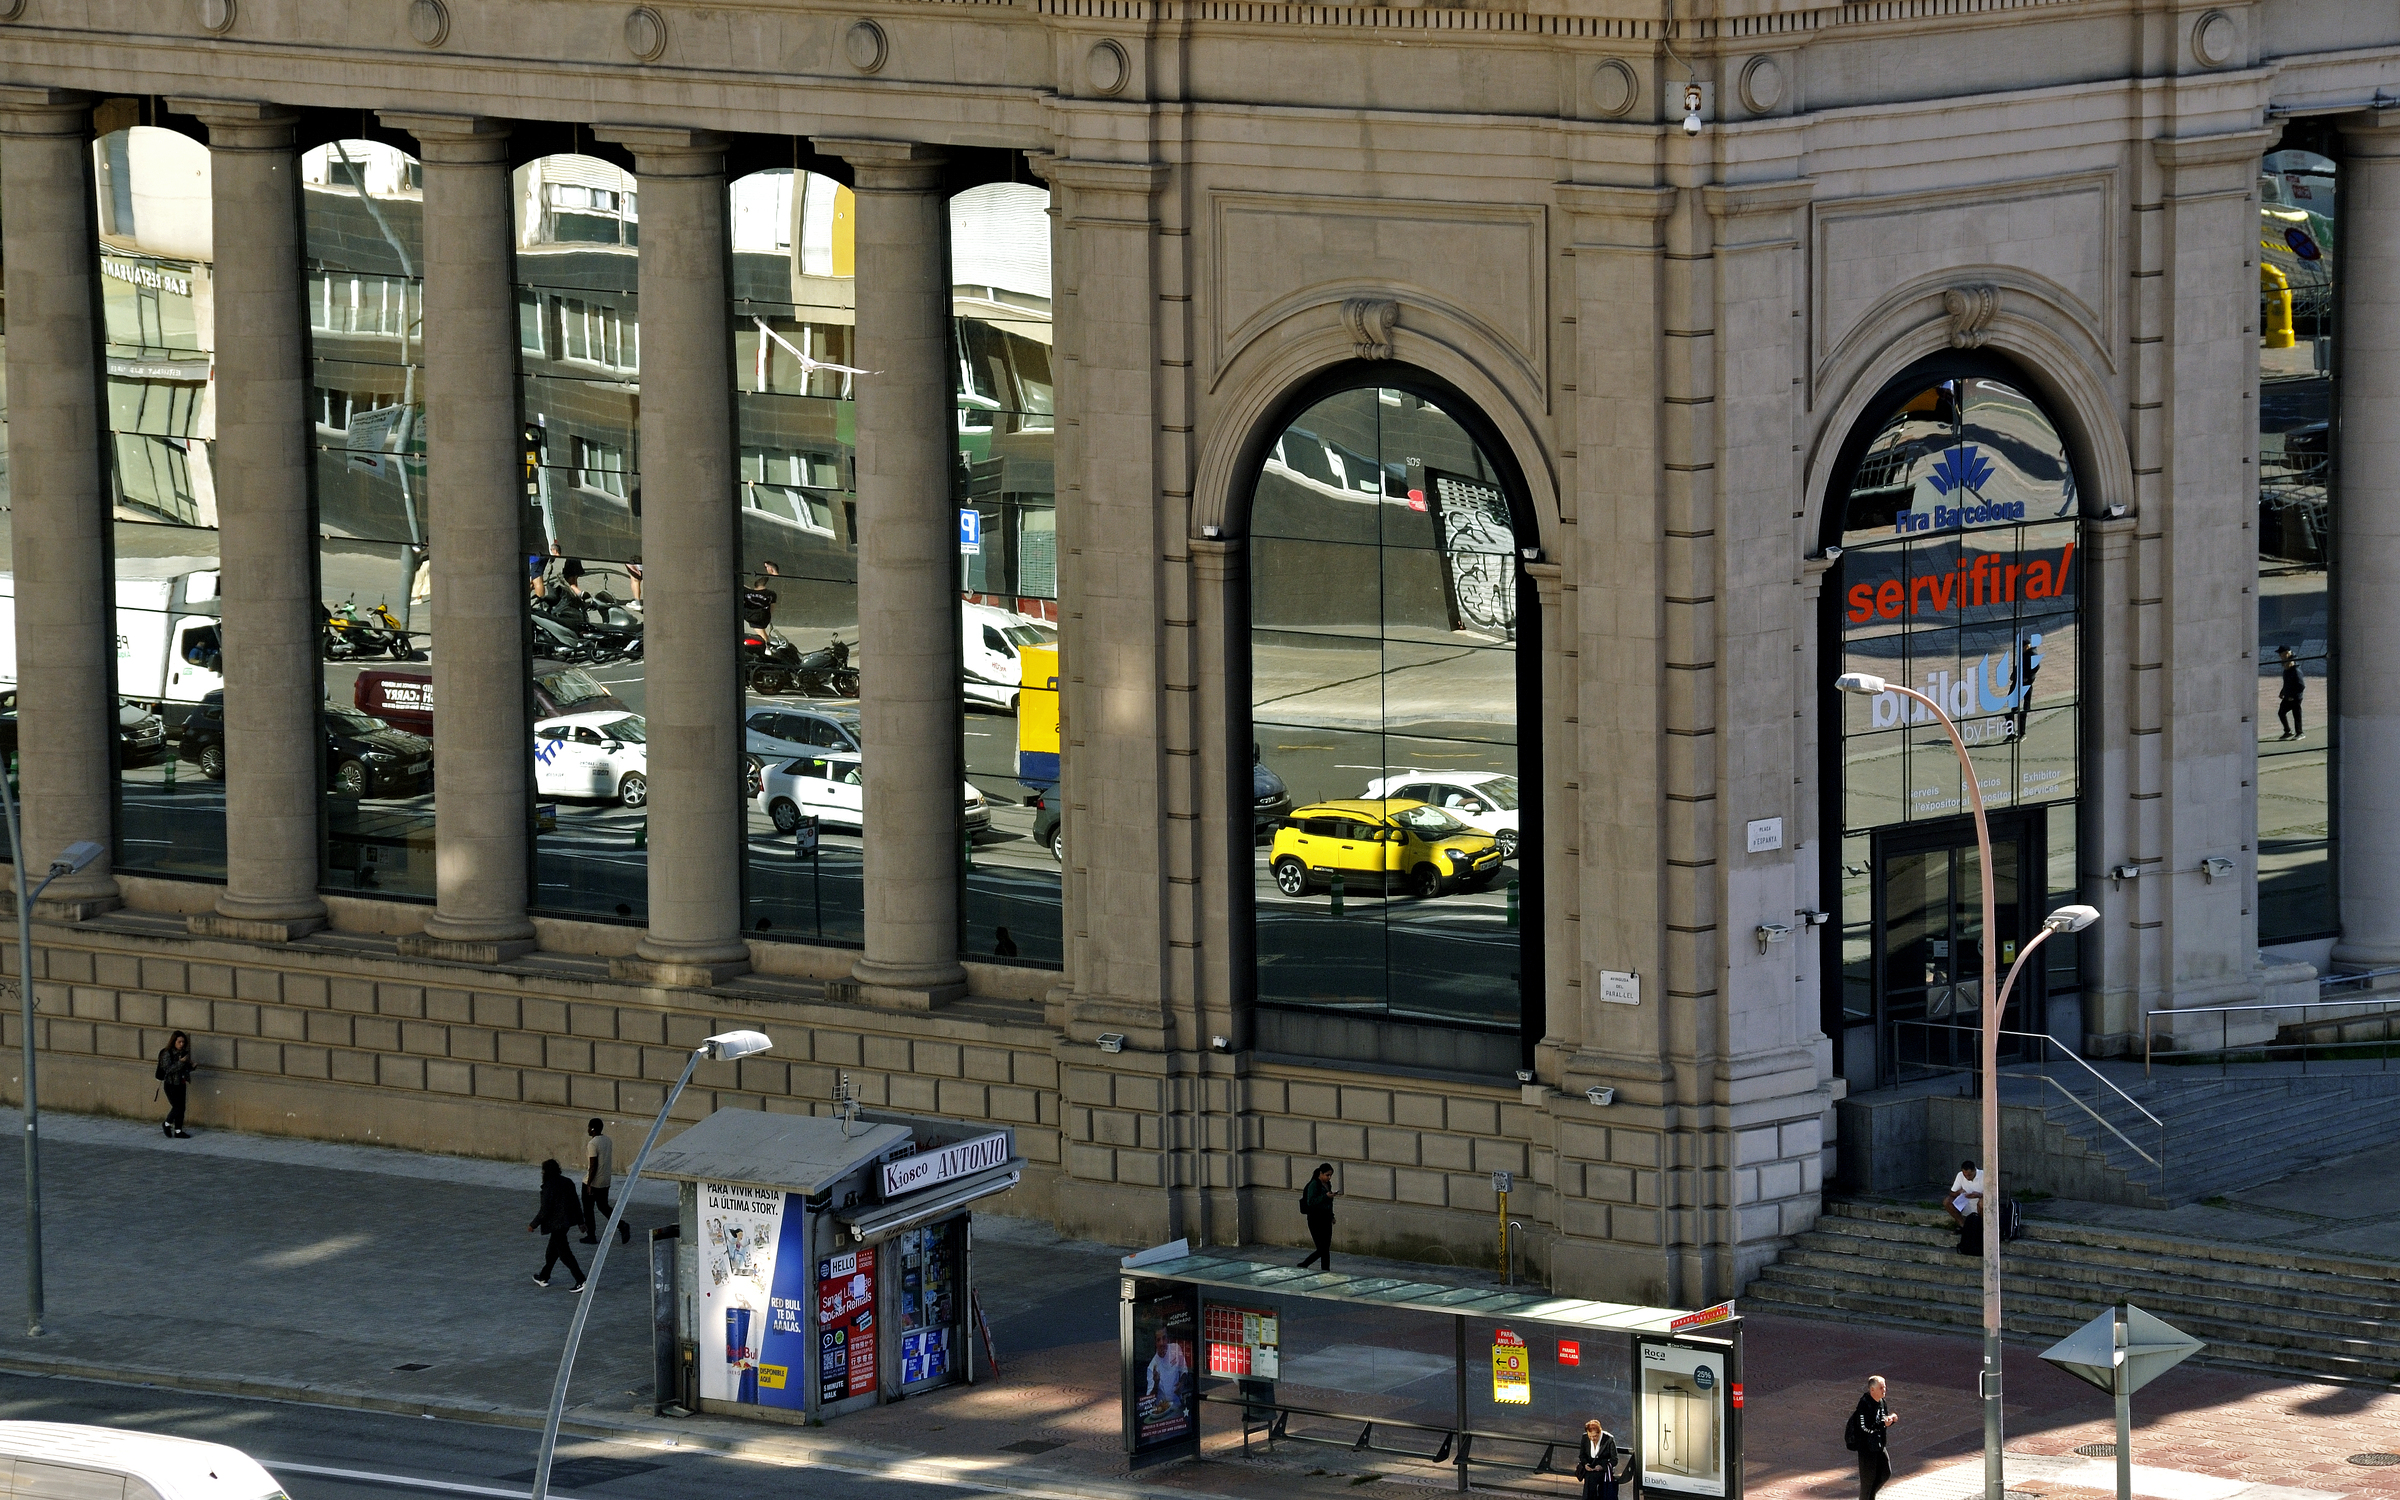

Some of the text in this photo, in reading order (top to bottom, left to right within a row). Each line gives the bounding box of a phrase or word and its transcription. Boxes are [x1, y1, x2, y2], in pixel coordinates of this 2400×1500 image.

[1896, 499, 2025, 533] Fira Barcelona
[1964, 718, 2014, 745] by Fira
[2023, 769, 2061, 783] Exhibitor
[1962, 777, 2001, 791] Svicios
[2023, 784, 2059, 797] Services
[1980, 789, 2012, 805] positor
[887, 1137, 1004, 1194] Kiosco ANTONIO
[707, 1183, 779, 1200] PARA VIVIR HASTA
[709, 1194, 778, 1216] LA ÚLTIMA STORY.
[832, 1257, 855, 1274] HELLO
[771, 1297, 801, 1311] RED BULL
[776, 1308, 795, 1321] TE DA
[1645, 1349, 1666, 1358] Roca
[1510, 1358, 1518, 1368] B
[760, 1367, 785, 1377] DISPONIBLE
[1697, 1370, 1711, 1379] 25%
[827, 1380, 844, 1391] MINUTE
[823, 1390, 837, 1399] WALK
